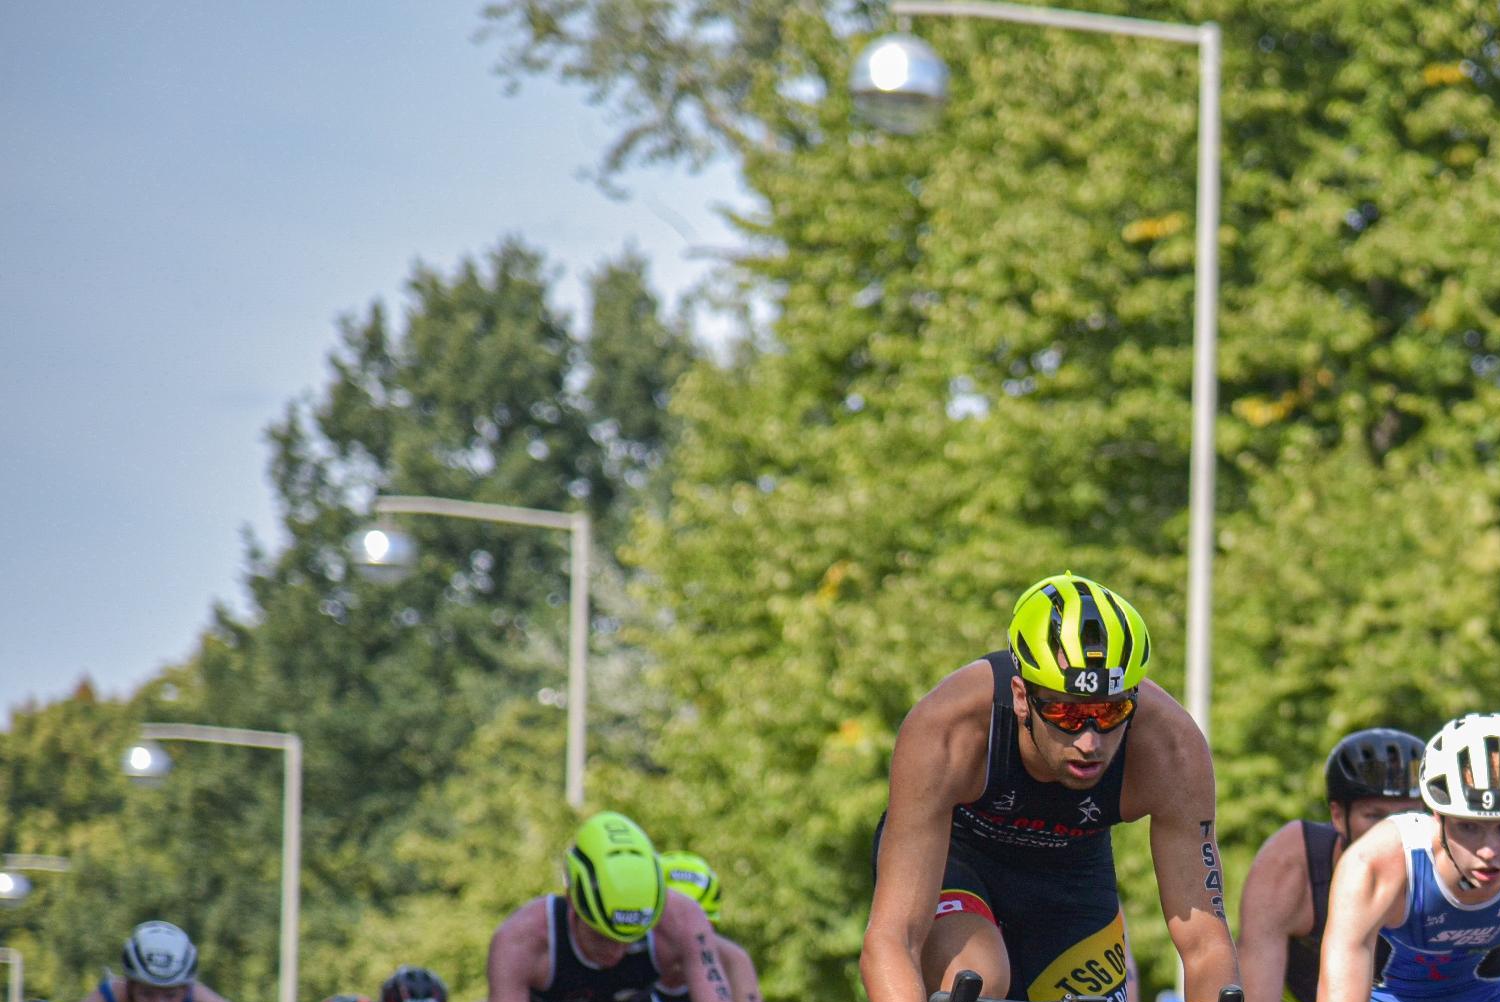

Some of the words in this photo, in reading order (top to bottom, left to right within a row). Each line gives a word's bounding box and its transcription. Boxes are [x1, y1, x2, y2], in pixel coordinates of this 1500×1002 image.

[1074, 671, 1098, 693] 43
[1481, 790, 1495, 810] 9
[1054, 959, 1113, 999] TSG
